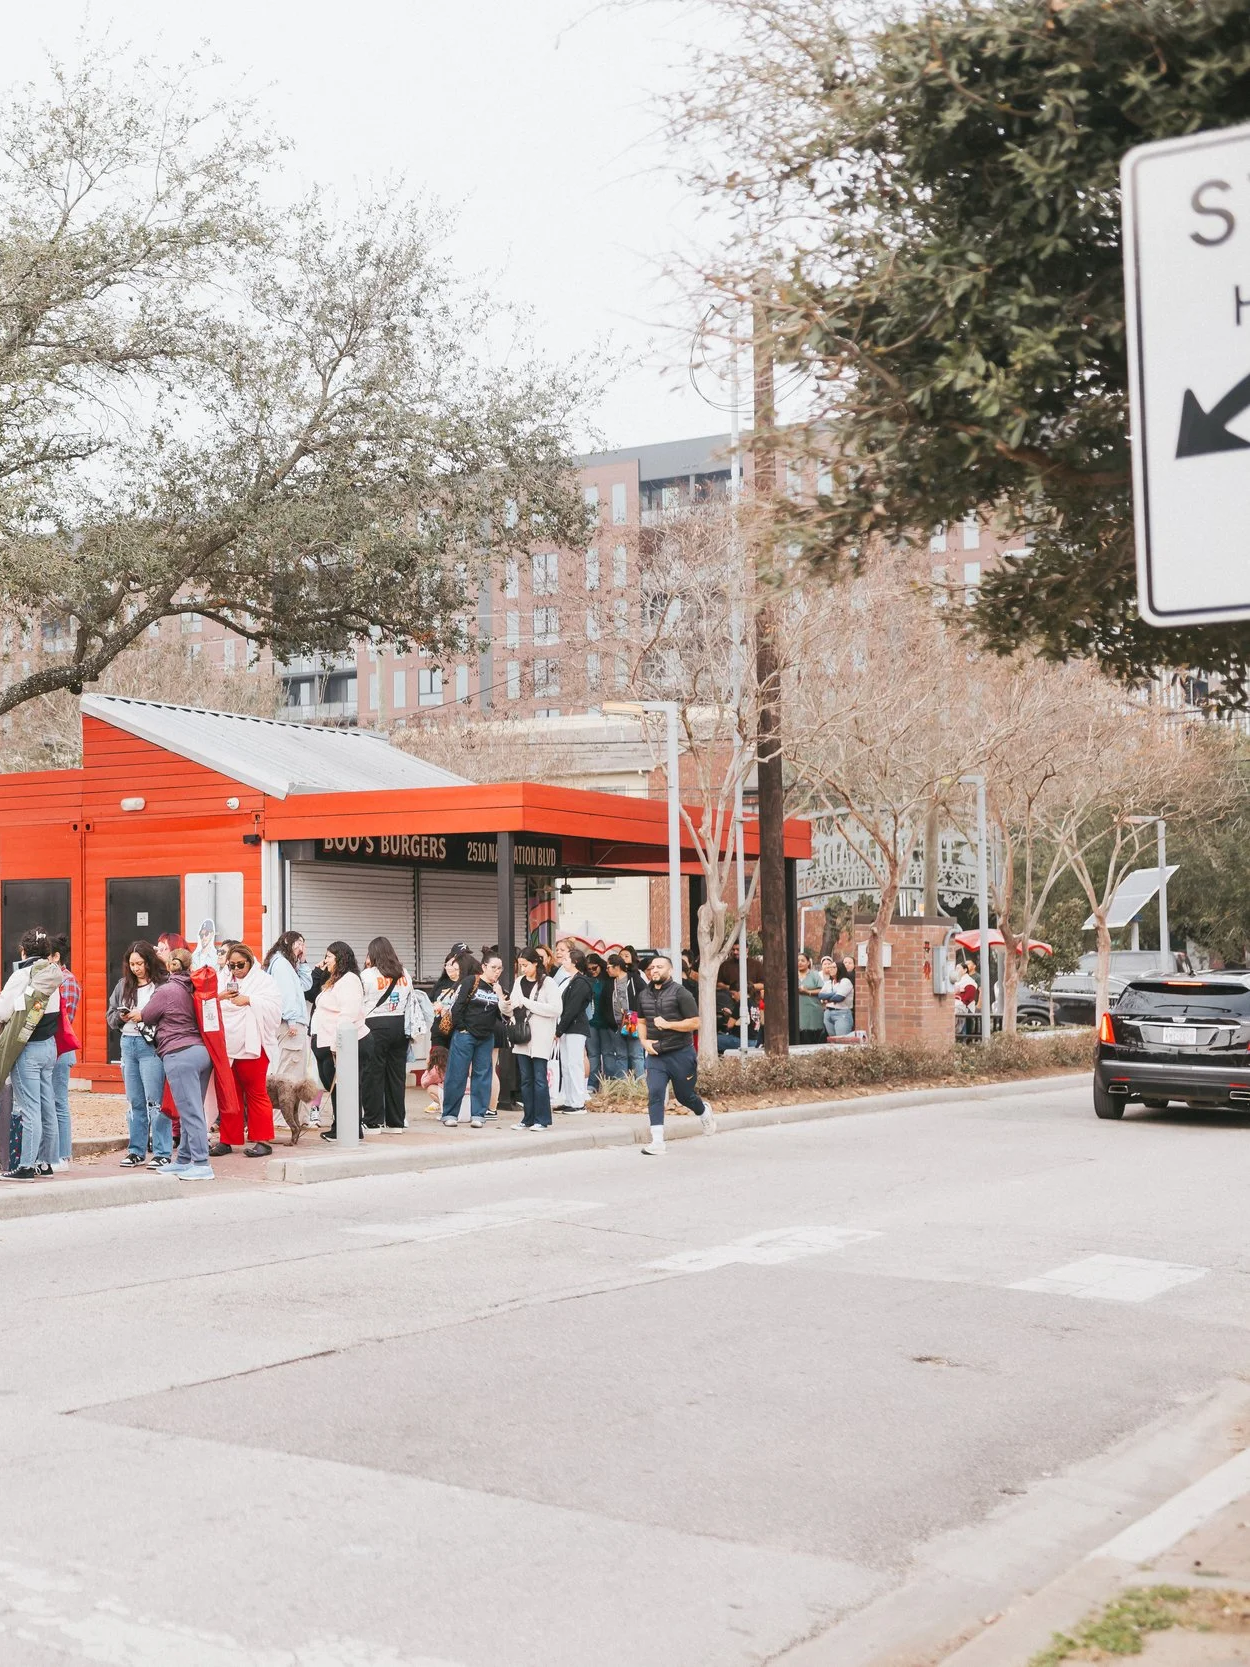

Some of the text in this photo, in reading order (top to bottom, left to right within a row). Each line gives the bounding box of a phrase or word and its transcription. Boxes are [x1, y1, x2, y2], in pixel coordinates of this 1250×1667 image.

[1189, 173, 1250, 247] S
[381, 835, 447, 859] BURGERS
[467, 841, 487, 863] 2510
[537, 847, 557, 867] BLVD
